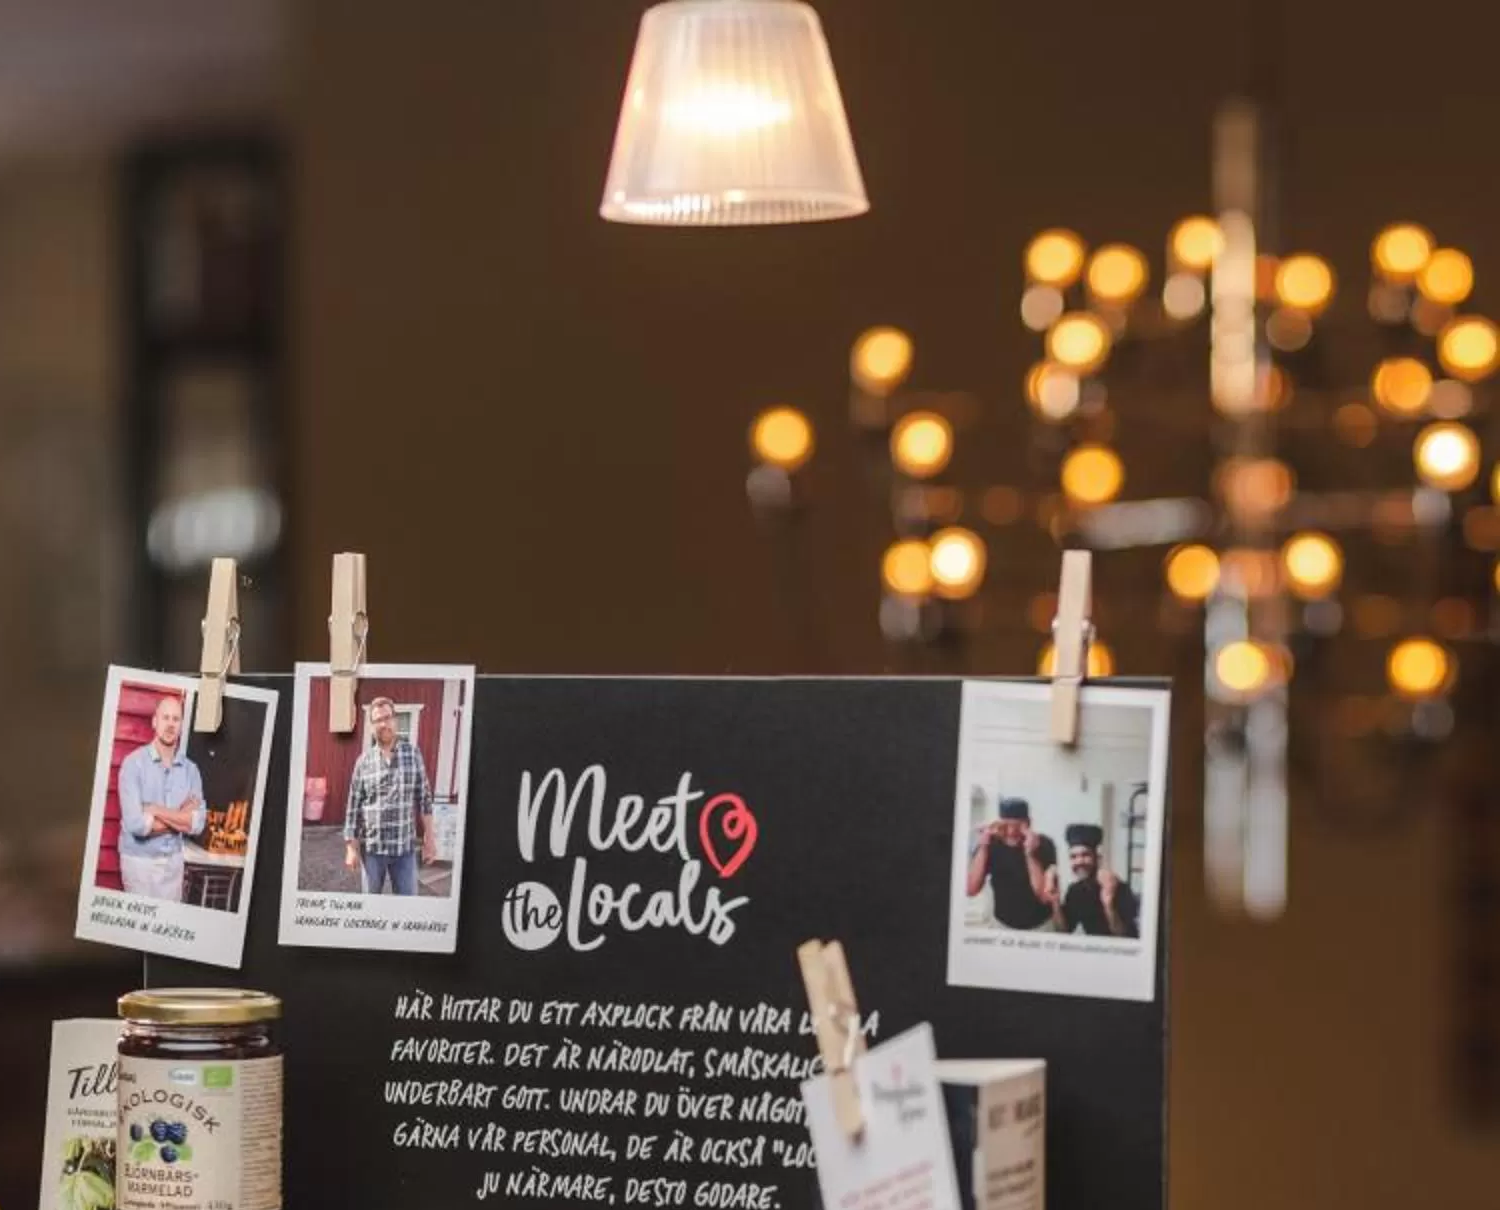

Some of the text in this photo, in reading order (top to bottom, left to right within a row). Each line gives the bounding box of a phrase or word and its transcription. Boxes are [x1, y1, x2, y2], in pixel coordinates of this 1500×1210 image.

[517, 765, 705, 862] Meet
[503, 857, 749, 951] the Locals
[395, 989, 433, 1020] HÄR
[441, 994, 501, 1023] HITTAR
[508, 1000, 532, 1024] DU
[540, 1000, 580, 1026] ETT
[580, 1001, 674, 1030] AXPLOCK
[679, 1001, 733, 1033] FRÅN
[738, 1002, 791, 1034] VÅRA
[390, 1037, 495, 1065] FAVORITER.
[503, 1043, 550, 1068] DET
[552, 1037, 582, 1070] ÄR
[587, 1039, 695, 1079] NÄRODLAT,
[384, 1078, 499, 1109] UNDERBART
[501, 1085, 551, 1110] GOTT.
[559, 1088, 637, 1116] UNDRAR
[644, 1093, 670, 1117] DU
[677, 1087, 734, 1121] ÖVER
[393, 1116, 460, 1149] GÄRNA
[467, 1121, 507, 1152] VÅR
[512, 1127, 617, 1162] PERSONAL,
[626, 1134, 658, 1160] DE
[663, 1130, 695, 1163] ÄR
[700, 1134, 767, 1168] OCKSÅ
[127, 1181, 194, 1199] MARMELAD
[476, 1165, 781, 1210] JU NÄRMARE, DESTO GODARE.
